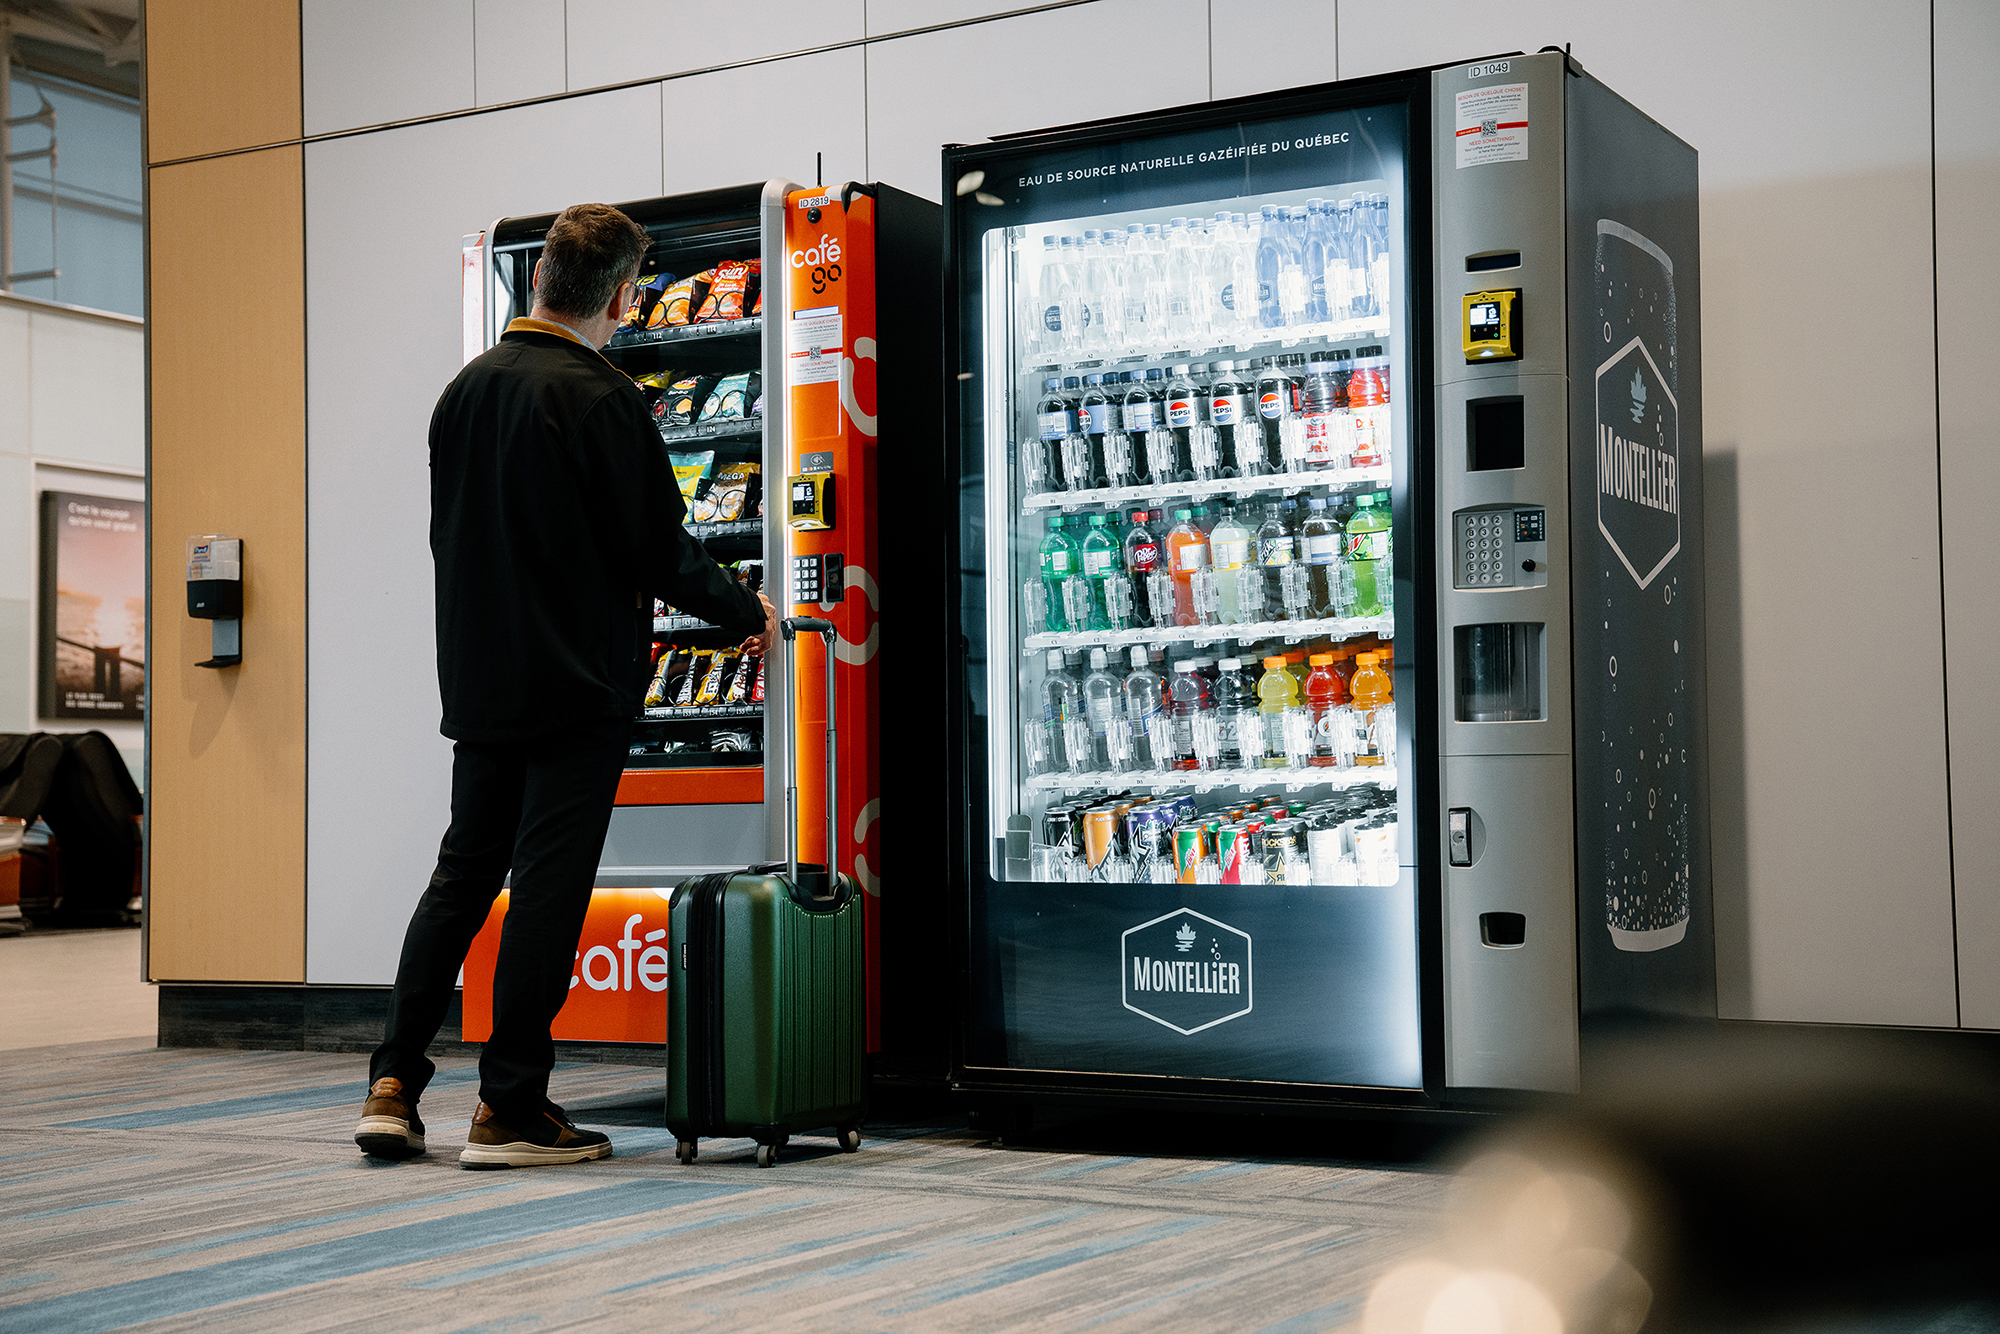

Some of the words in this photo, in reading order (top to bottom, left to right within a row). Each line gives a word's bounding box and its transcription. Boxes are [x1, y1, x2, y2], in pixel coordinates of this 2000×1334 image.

[1470, 66, 1481, 78] ID
[1484, 62, 1508, 75] 1049
[1483, 136, 1515, 144] SOMETHING?
[1018, 175, 1043, 188] EAU
[1047, 172, 1063, 184] DE
[1067, 165, 1117, 182] SOURCE
[1120, 155, 1194, 174] NATURELLE
[1198, 142, 1268, 164] GAZÉIFIÉE
[1272, 140, 1290, 153] DU
[1294, 131, 1350, 150] QUÉBEC
[800, 200, 809, 208] ID
[810, 197, 829, 207] 2819
[791, 234, 842, 268] café
[812, 264, 842, 294] go
[717, 472, 745, 480] MEGA
